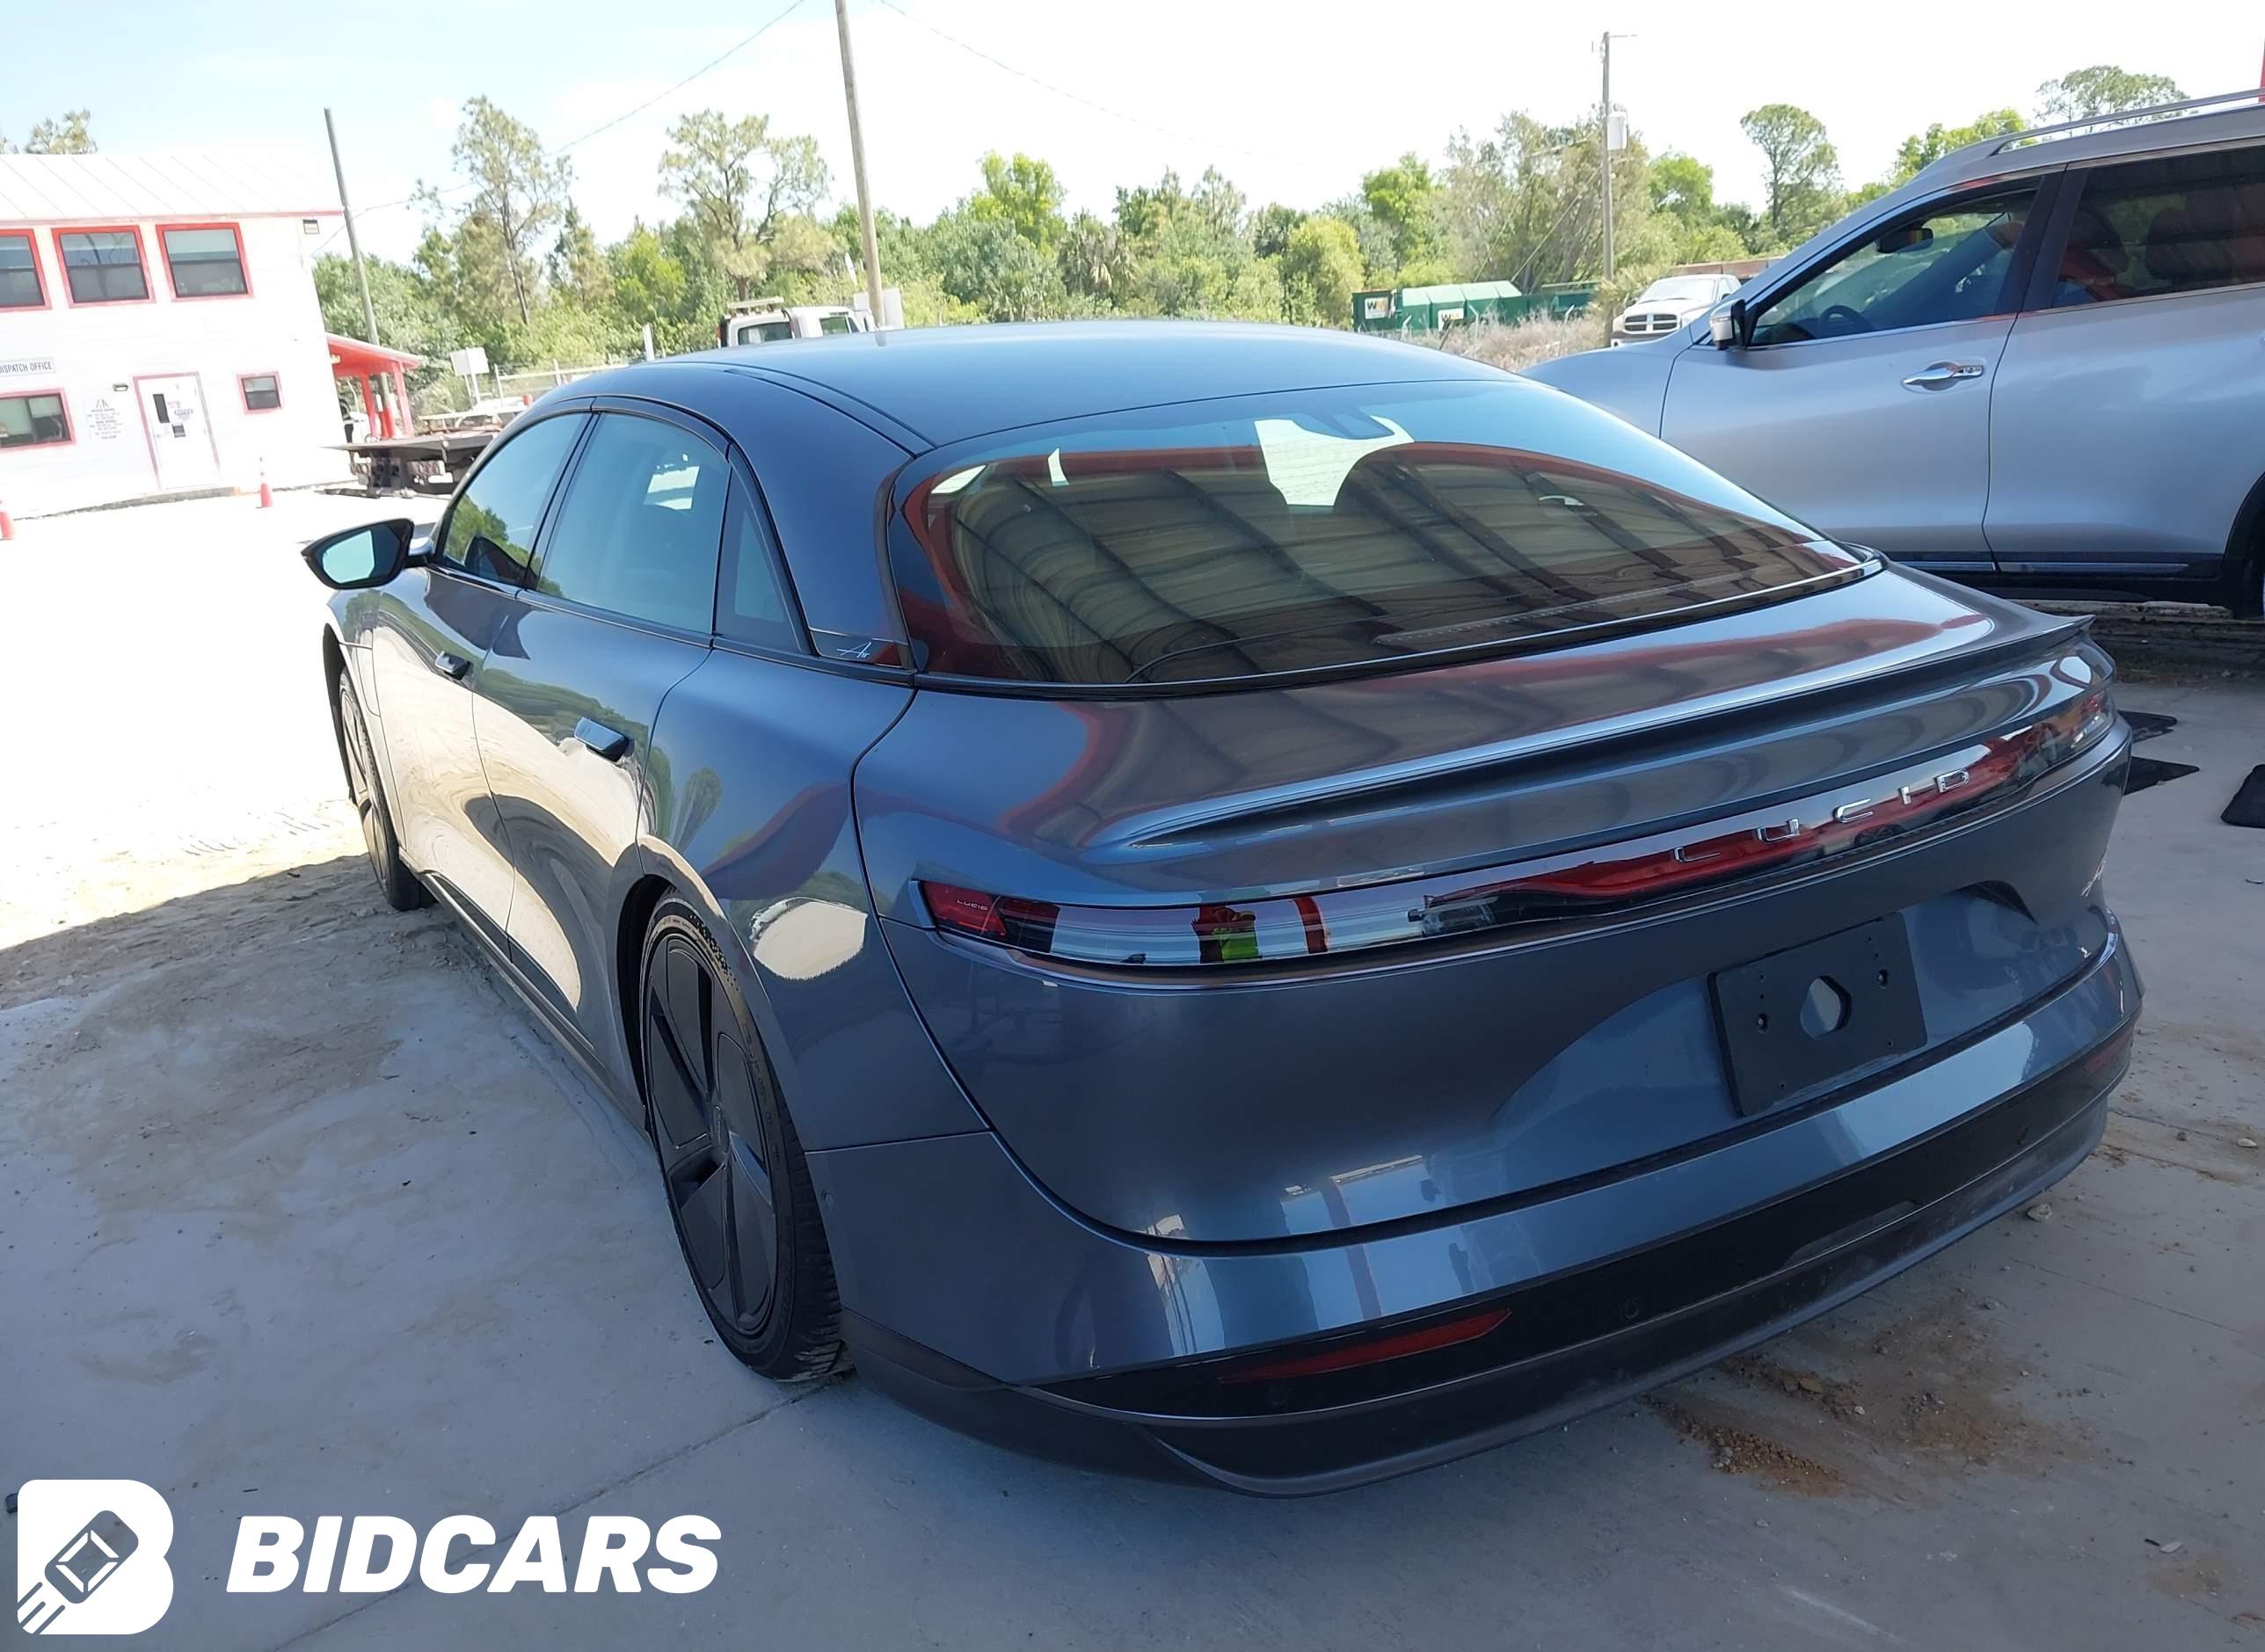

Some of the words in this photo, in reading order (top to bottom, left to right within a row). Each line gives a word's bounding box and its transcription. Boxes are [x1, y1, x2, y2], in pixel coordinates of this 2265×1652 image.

[30, 360, 53, 372] OFFICE
[837, 641, 872, 659] Air
[1672, 768, 1970, 863] LUCID
[957, 898, 988, 911] LUCID
